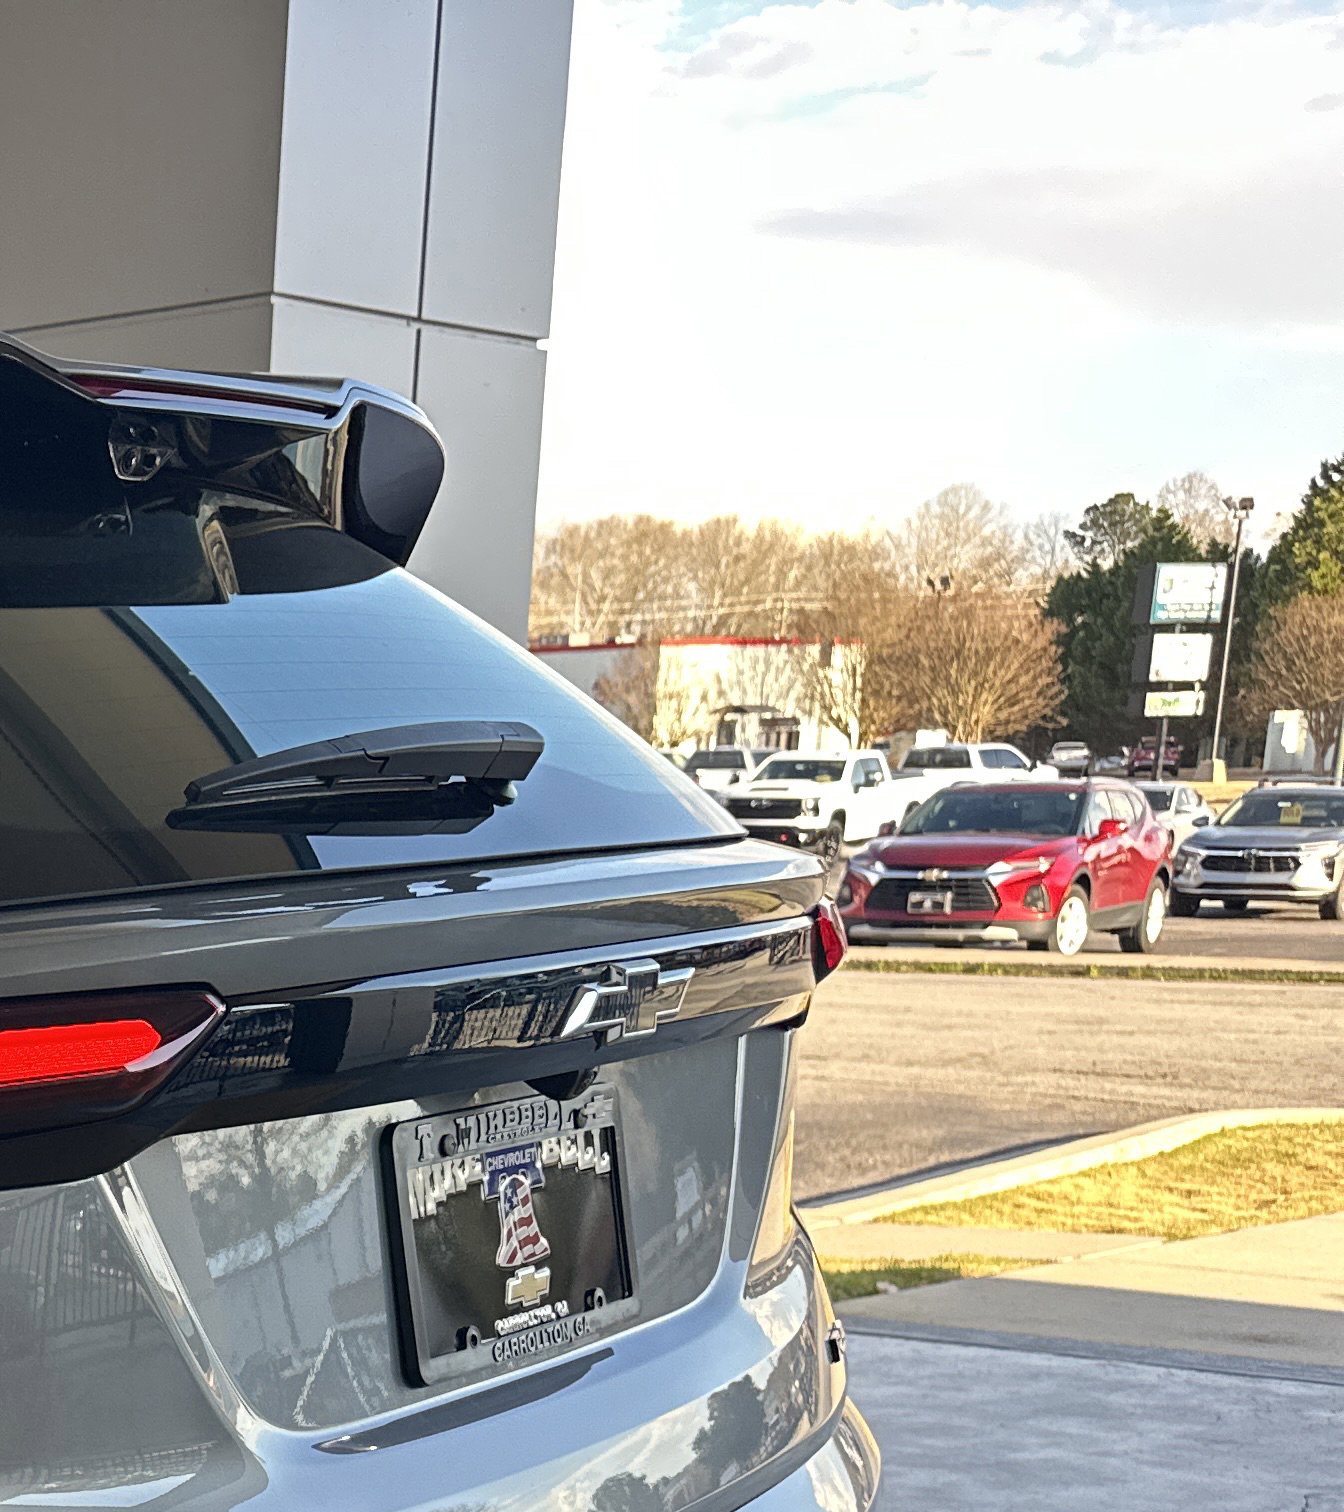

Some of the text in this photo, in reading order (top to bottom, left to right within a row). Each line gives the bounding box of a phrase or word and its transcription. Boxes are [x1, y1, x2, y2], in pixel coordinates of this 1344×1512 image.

[485, 1148, 539, 1171] CHEVROLET
[493, 1315, 592, 1362] CARROLLTON, GA
